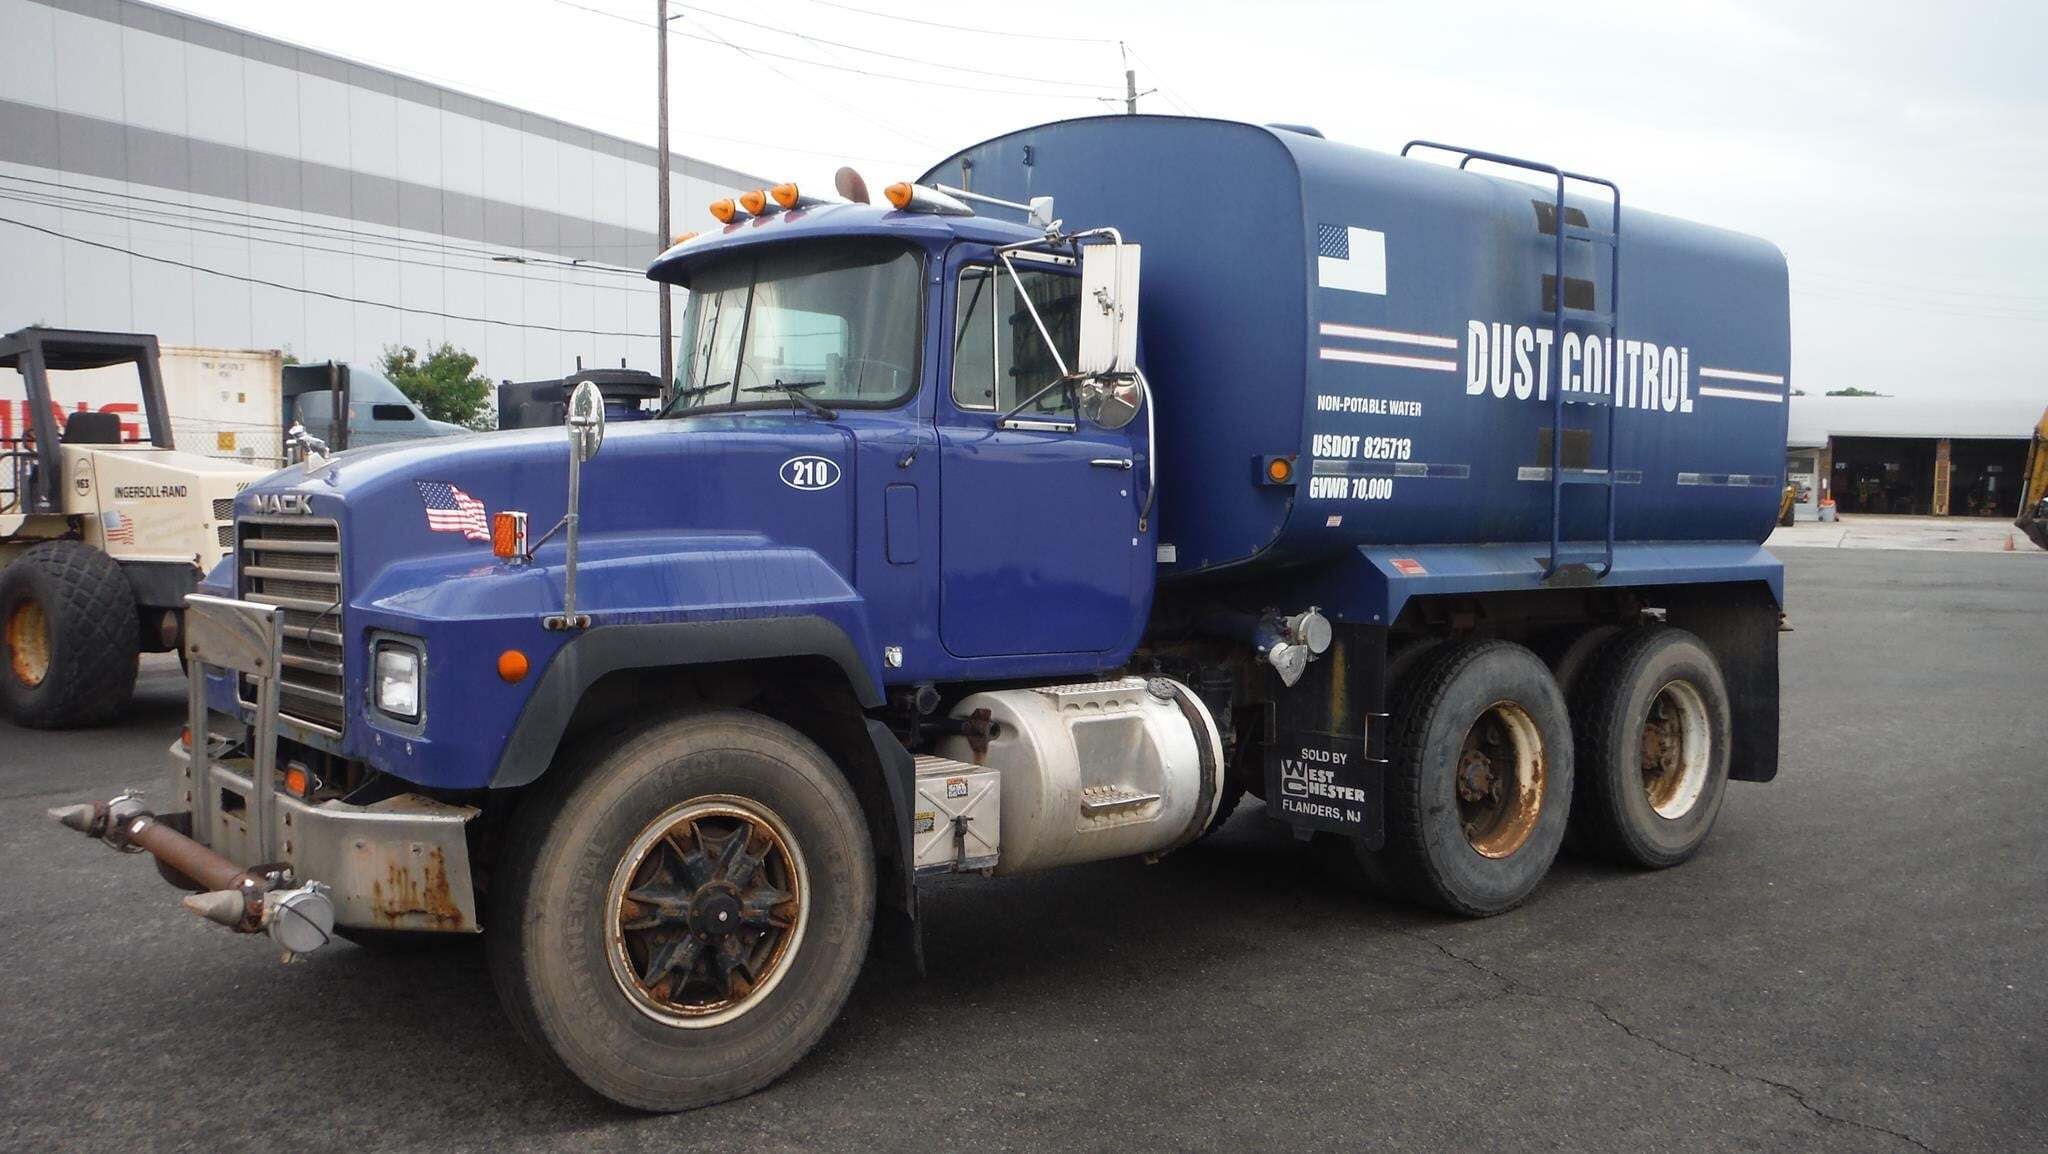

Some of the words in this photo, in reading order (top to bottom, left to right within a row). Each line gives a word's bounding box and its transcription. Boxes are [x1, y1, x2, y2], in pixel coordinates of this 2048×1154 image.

[1466, 320, 1553, 401] DUST
[1562, 331, 1693, 412] CONTROL
[1317, 394, 1387, 414] NON-POTABLE
[1389, 400, 1422, 416] WATER
[1312, 434, 1360, 458] USDOT
[1363, 436, 1411, 460] 825713
[793, 461, 827, 485] 210
[114, 486, 187, 498] INGERSOLL-RAND
[1309, 477, 1348, 499] GVWR
[1351, 478, 1393, 500] 70,000
[254, 494, 313, 514] MACK
[1301, 748, 1330, 762] SOLD
[1332, 752, 1347, 765] BY
[1282, 799, 1344, 821] FLANDERS,
[1346, 809, 1361, 823] NJ
